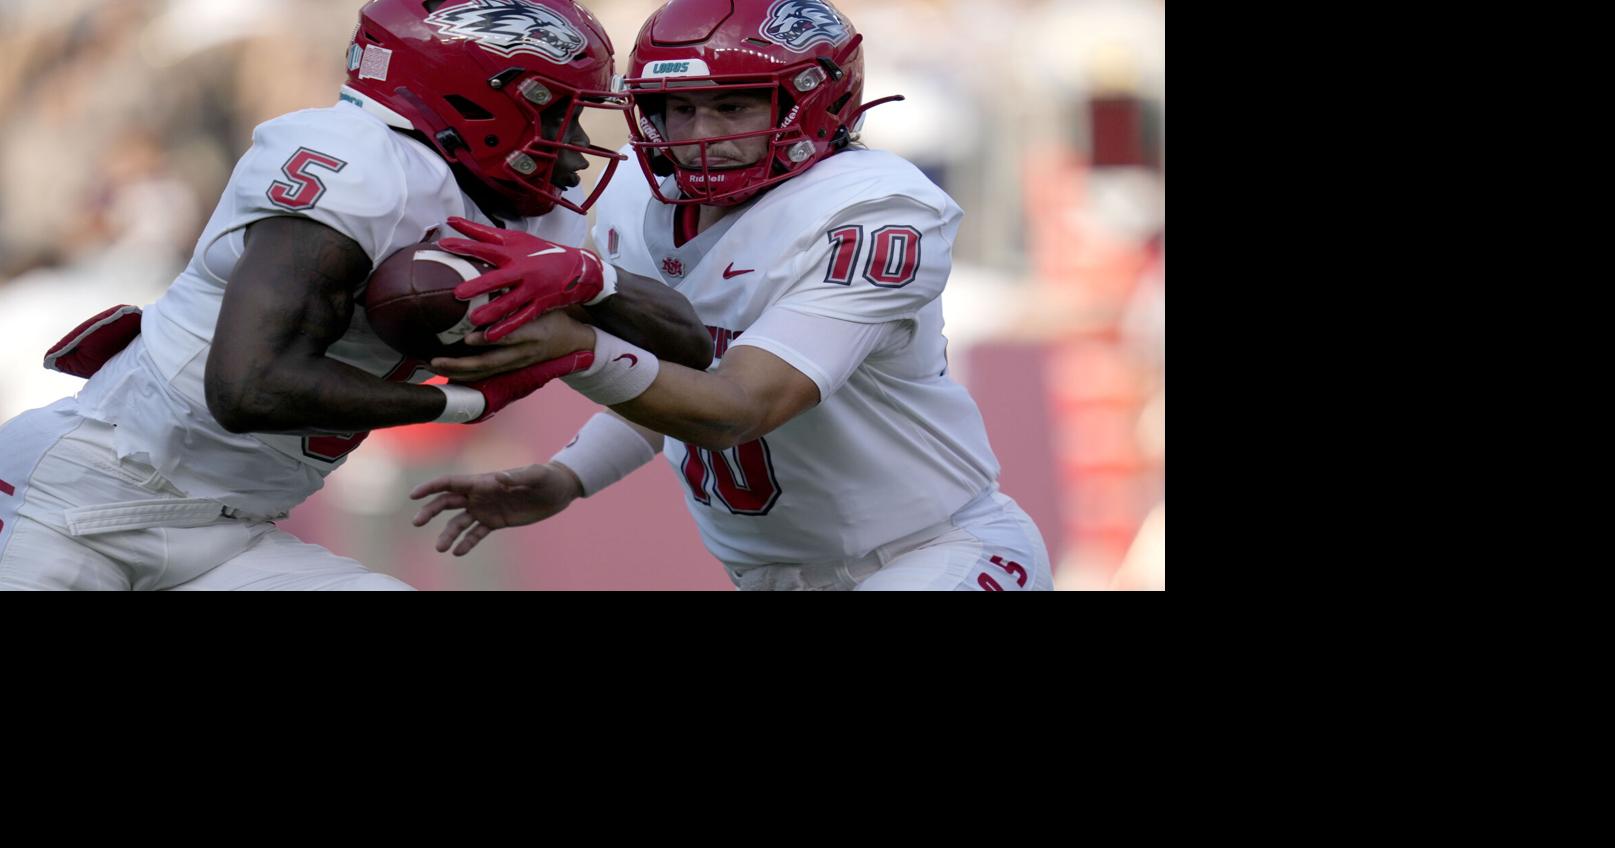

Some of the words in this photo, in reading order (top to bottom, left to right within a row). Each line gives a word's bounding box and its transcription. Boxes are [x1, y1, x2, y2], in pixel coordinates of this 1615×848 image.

[653, 62, 689, 73] LOBOS
[265, 146, 348, 211] 5
[823, 224, 922, 288] 10
